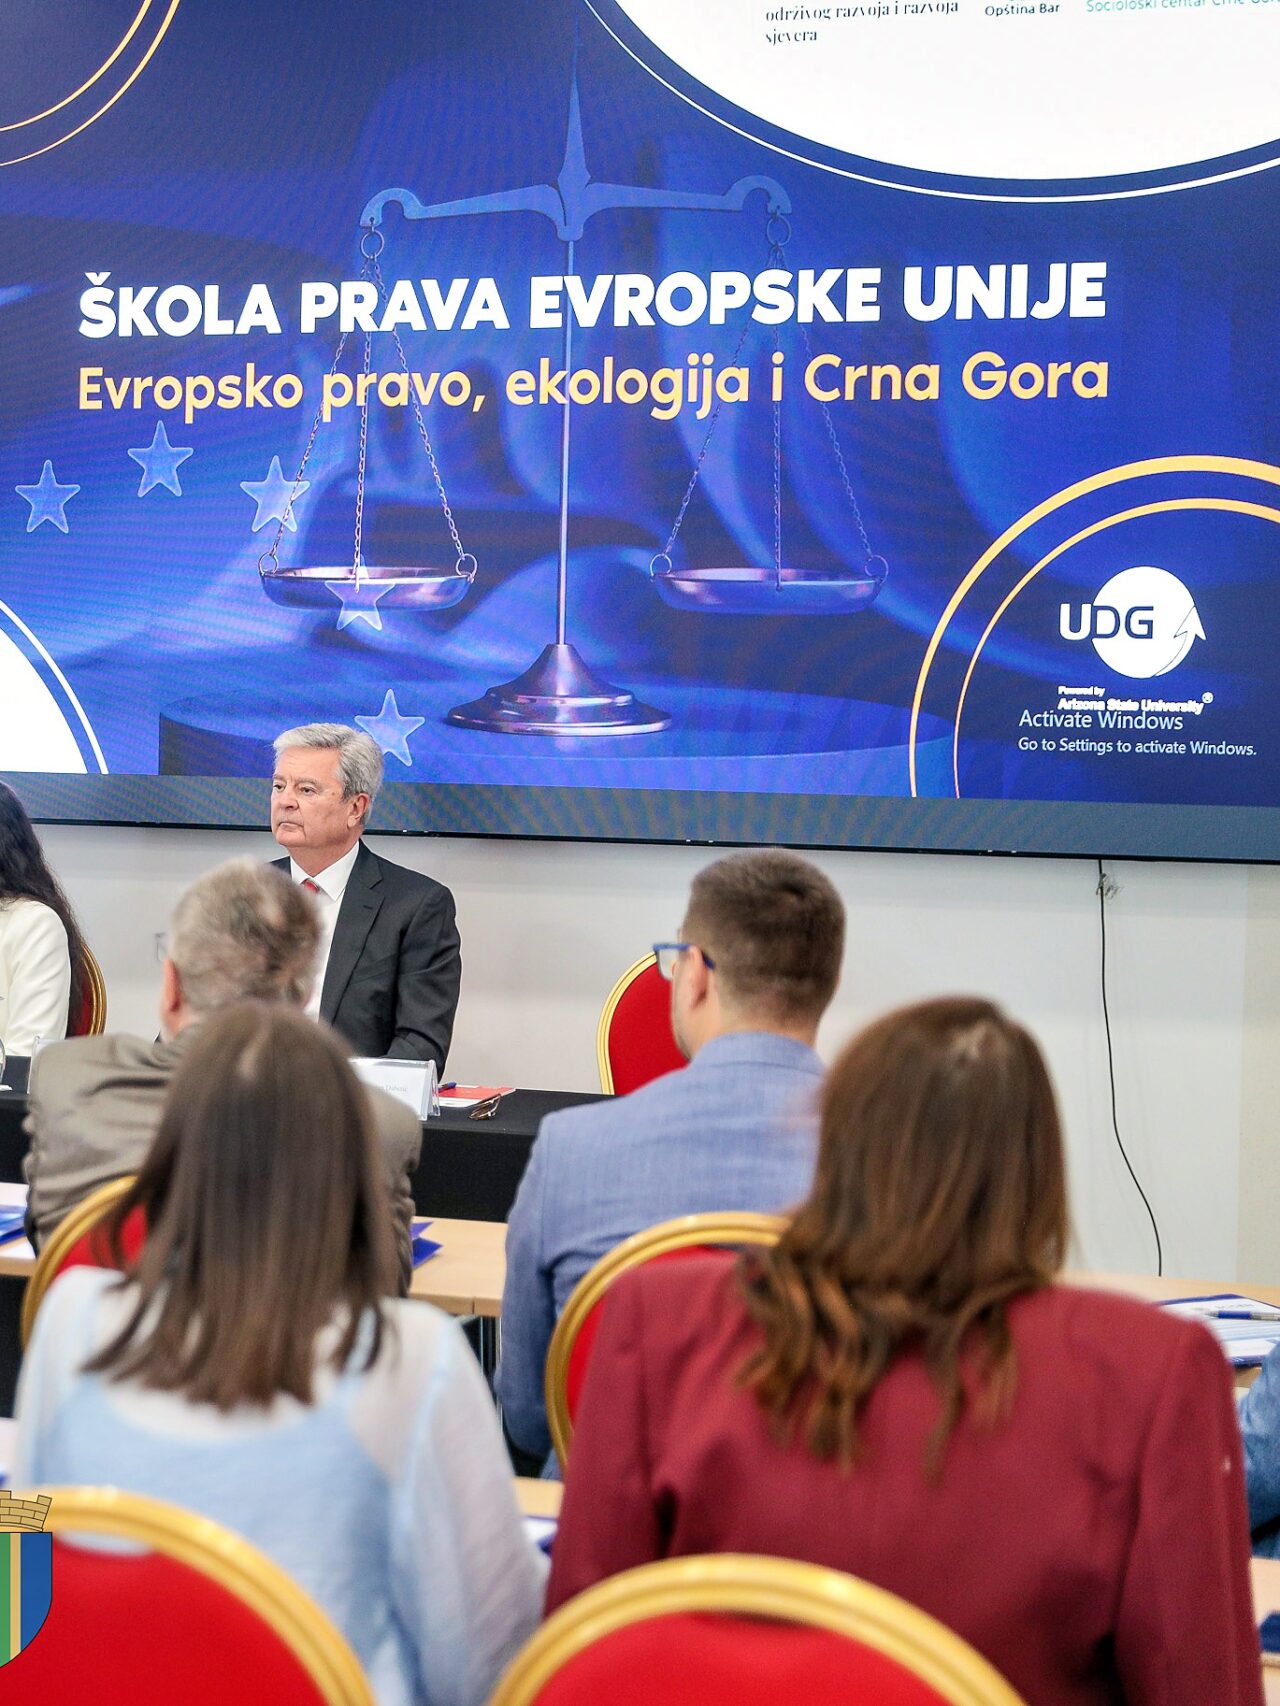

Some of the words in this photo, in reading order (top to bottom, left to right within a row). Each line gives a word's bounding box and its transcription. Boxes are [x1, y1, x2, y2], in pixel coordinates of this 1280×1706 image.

[836, 2, 890, 18] razvoja
[894, 1, 899, 15] i
[1039, 3, 1060, 13] Bar
[766, 29, 818, 45] sjevera
[78, 272, 282, 338] ŠKOLA
[300, 277, 510, 333] PRAVA
[529, 267, 882, 329] EVROPSKE
[903, 262, 1107, 322] UNIJE
[78, 362, 304, 424] Evropsko
[322, 370, 486, 423] pravo,
[506, 352, 750, 420] ekologija
[771, 351, 785, 401] i
[804, 353, 940, 402] Crna
[961, 350, 1109, 399] Gora
[1058, 603, 1154, 641] UDG
[1019, 709, 1093, 728] Activate
[1097, 711, 1184, 730] Windows
[1018, 737, 1038, 751] Go
[1041, 738, 1056, 751] to
[1059, 738, 1114, 756] Settings
[1116, 740, 1132, 753] to
[1135, 740, 1187, 754] activate
[1189, 741, 1257, 756] Windows.
